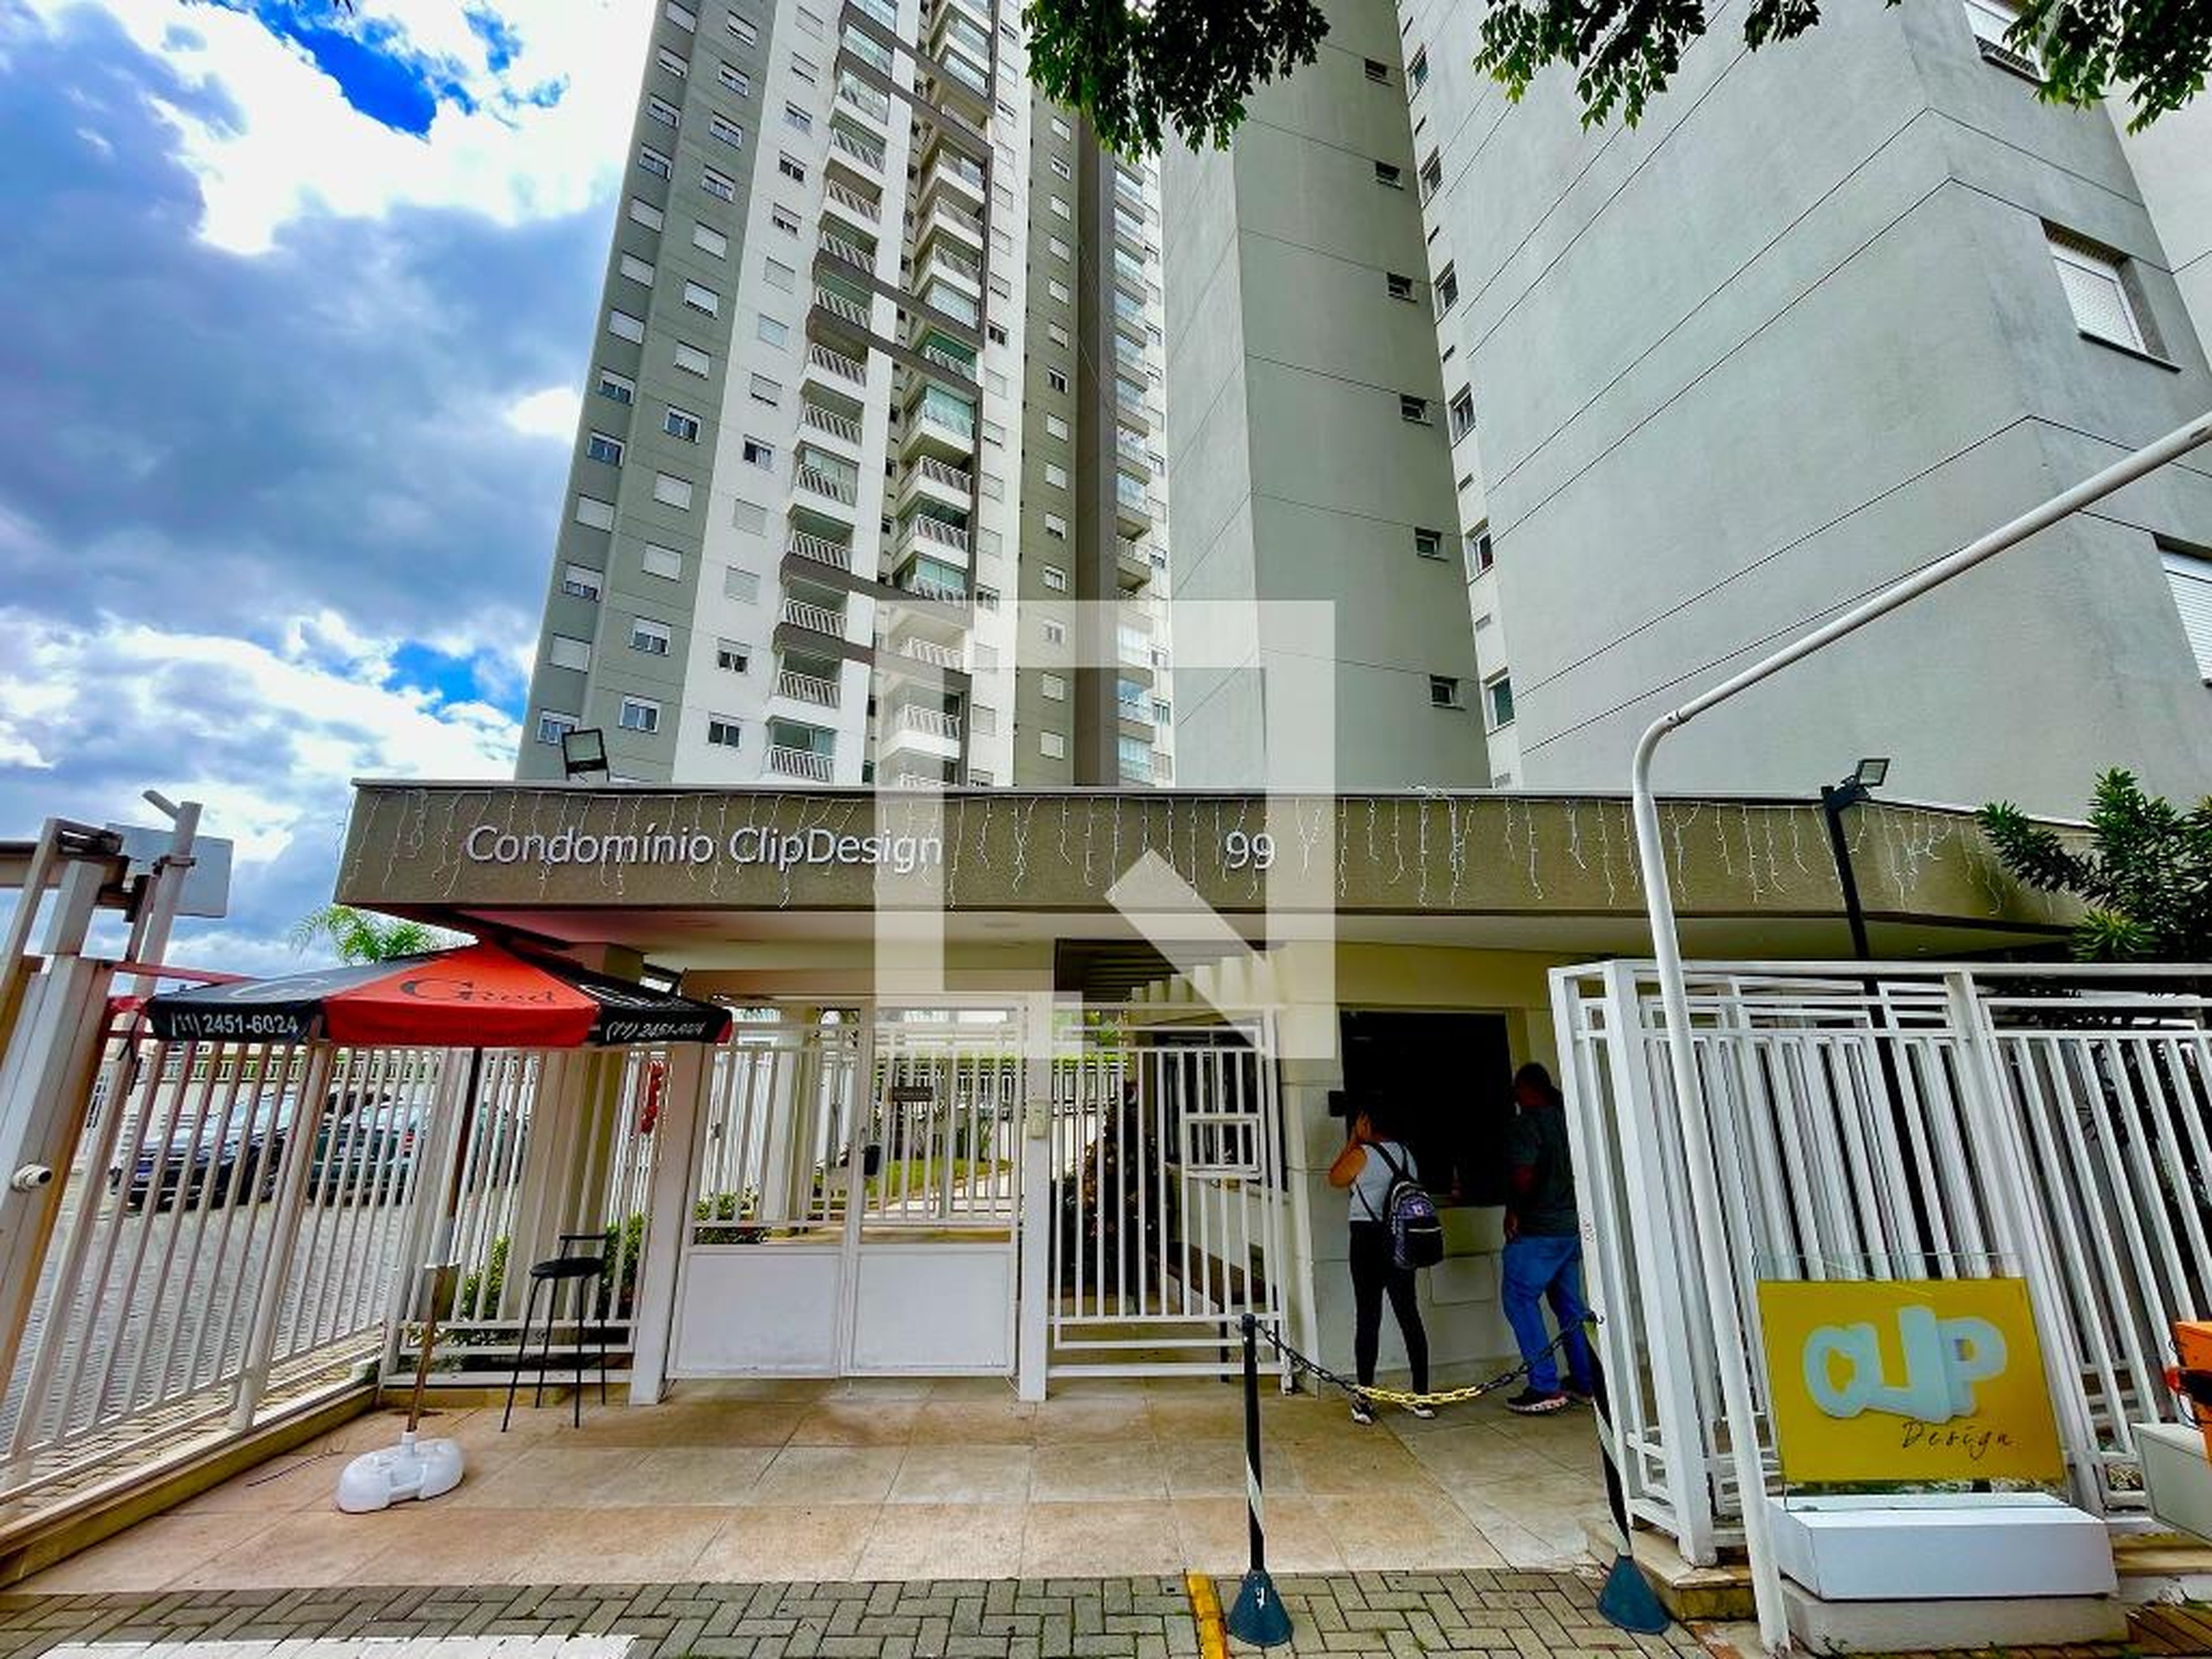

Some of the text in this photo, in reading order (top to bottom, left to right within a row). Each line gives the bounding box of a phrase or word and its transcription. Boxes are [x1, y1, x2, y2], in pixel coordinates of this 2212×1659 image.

[466, 823, 943, 874] Condomínio ClipDesign
[1226, 831, 1275, 869] 99
[202, 1014, 299, 1035] 2451-6024
[1902, 1421, 2013, 1461] Design
